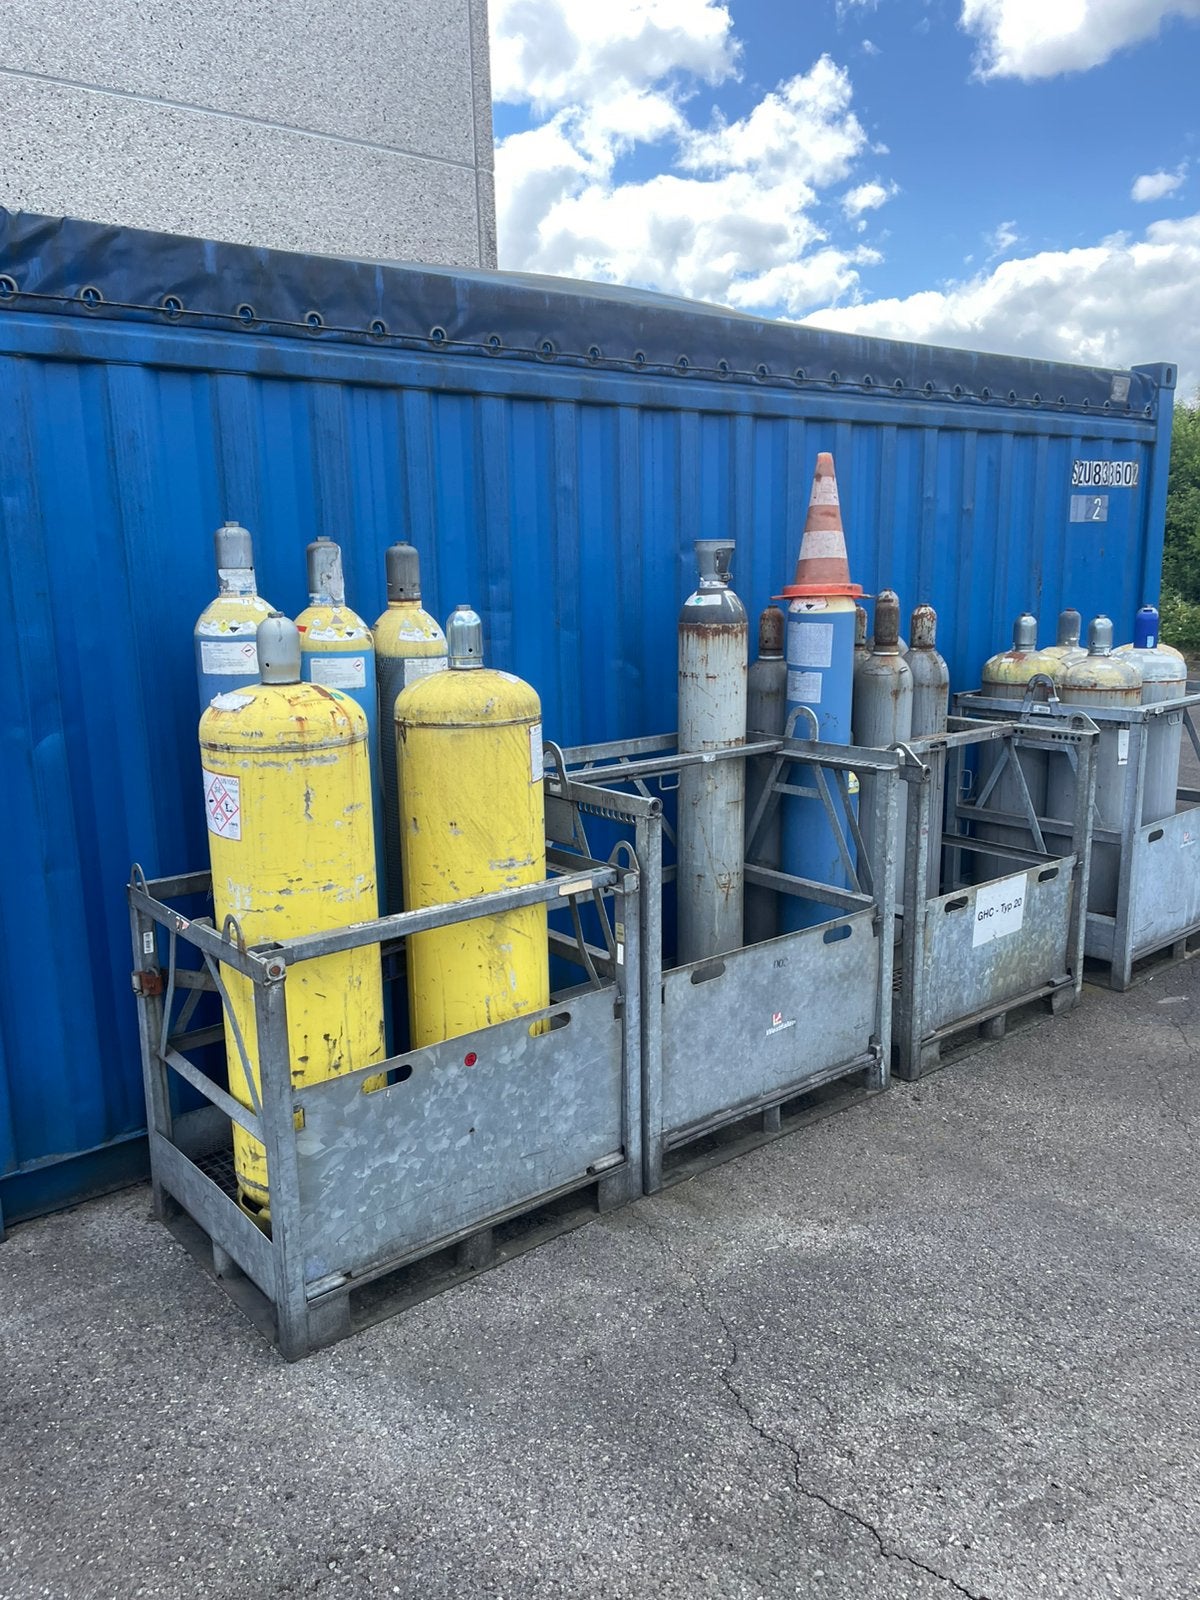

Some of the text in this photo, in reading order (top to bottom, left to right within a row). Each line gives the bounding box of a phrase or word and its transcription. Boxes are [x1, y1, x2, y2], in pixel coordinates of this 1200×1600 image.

[1092, 497, 1102, 520] 2
[977, 907, 995, 921] GHC
[1000, 902, 1013, 914] Typ
